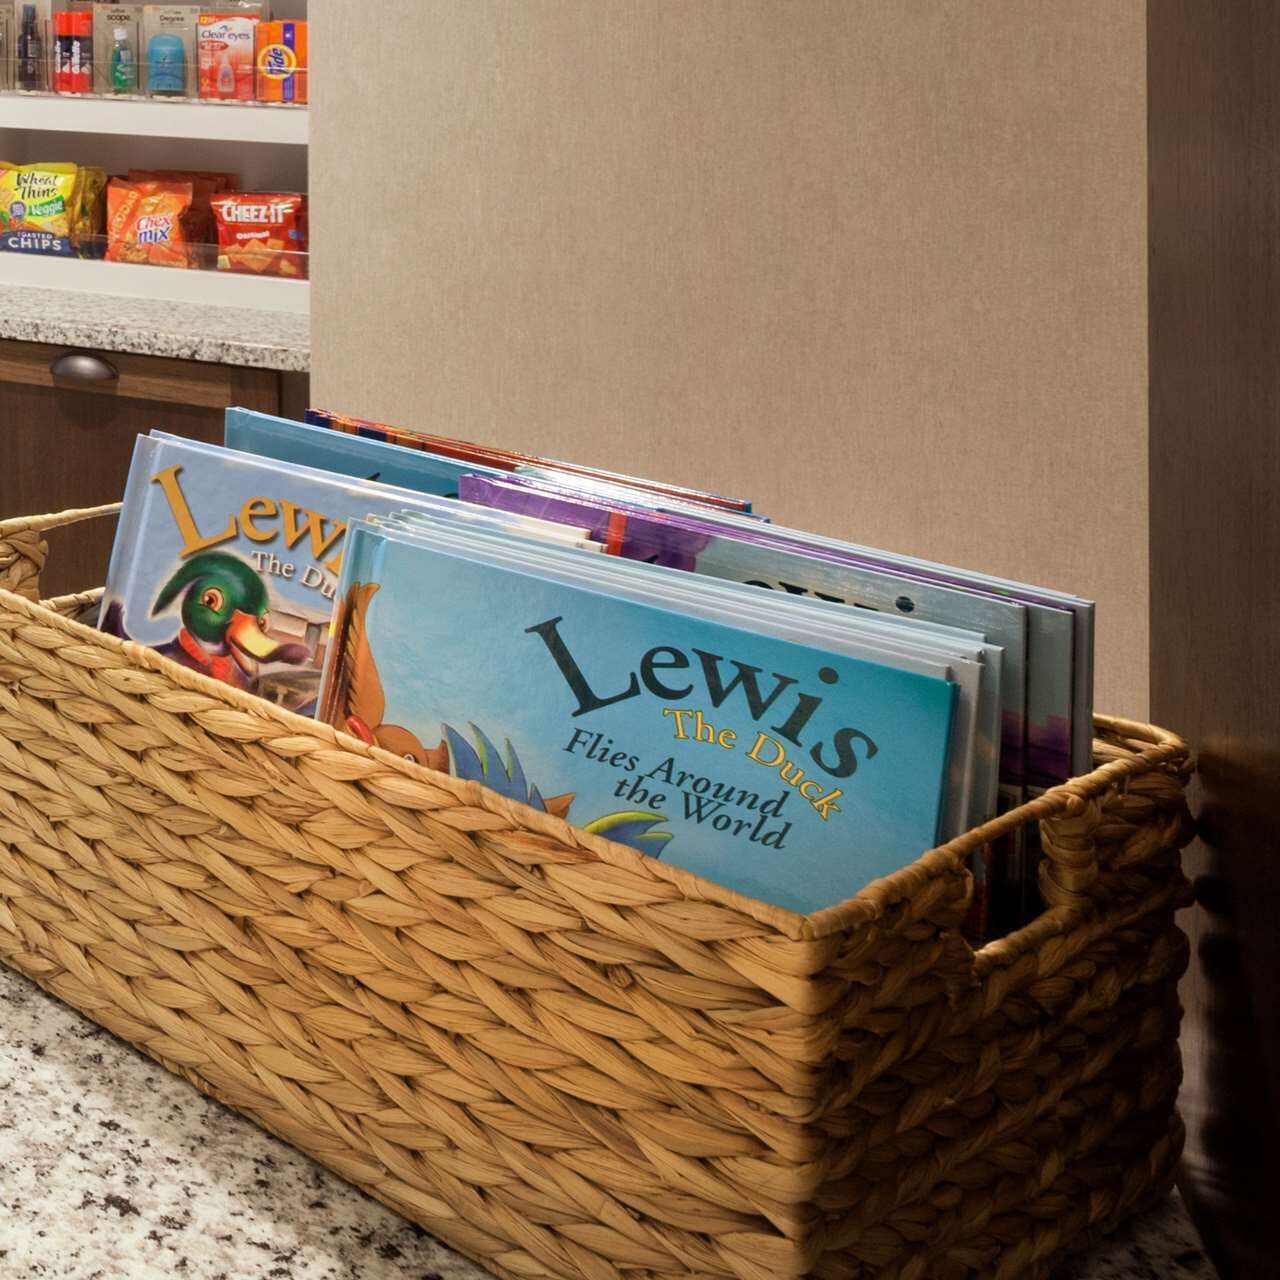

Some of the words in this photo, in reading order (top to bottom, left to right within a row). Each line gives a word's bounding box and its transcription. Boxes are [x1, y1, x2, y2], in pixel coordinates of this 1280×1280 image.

[106, 14, 131, 23] scope
[159, 15, 185, 23] Degree
[201, 30, 226, 41] Clear
[227, 31, 251, 42] eyes
[266, 47, 289, 76] Tide
[16, 172, 61, 187] Wheat
[14, 187, 58, 201] Thins
[31, 201, 64, 217] Veggie
[136, 214, 171, 231] Chex
[17, 231, 53, 240] TOASTED
[7, 237, 63, 251] CHIPS
[150, 463, 348, 578] Lew
[251, 550, 295, 578] The
[301, 565, 339, 601] Du
[524, 615, 879, 779] Lewis
[662, 707, 737, 749] The
[745, 731, 844, 822] Duck
[562, 727, 640, 772] Flies
[643, 756, 790, 820] Around
[612, 774, 667, 811] the
[680, 790, 793, 850] World
